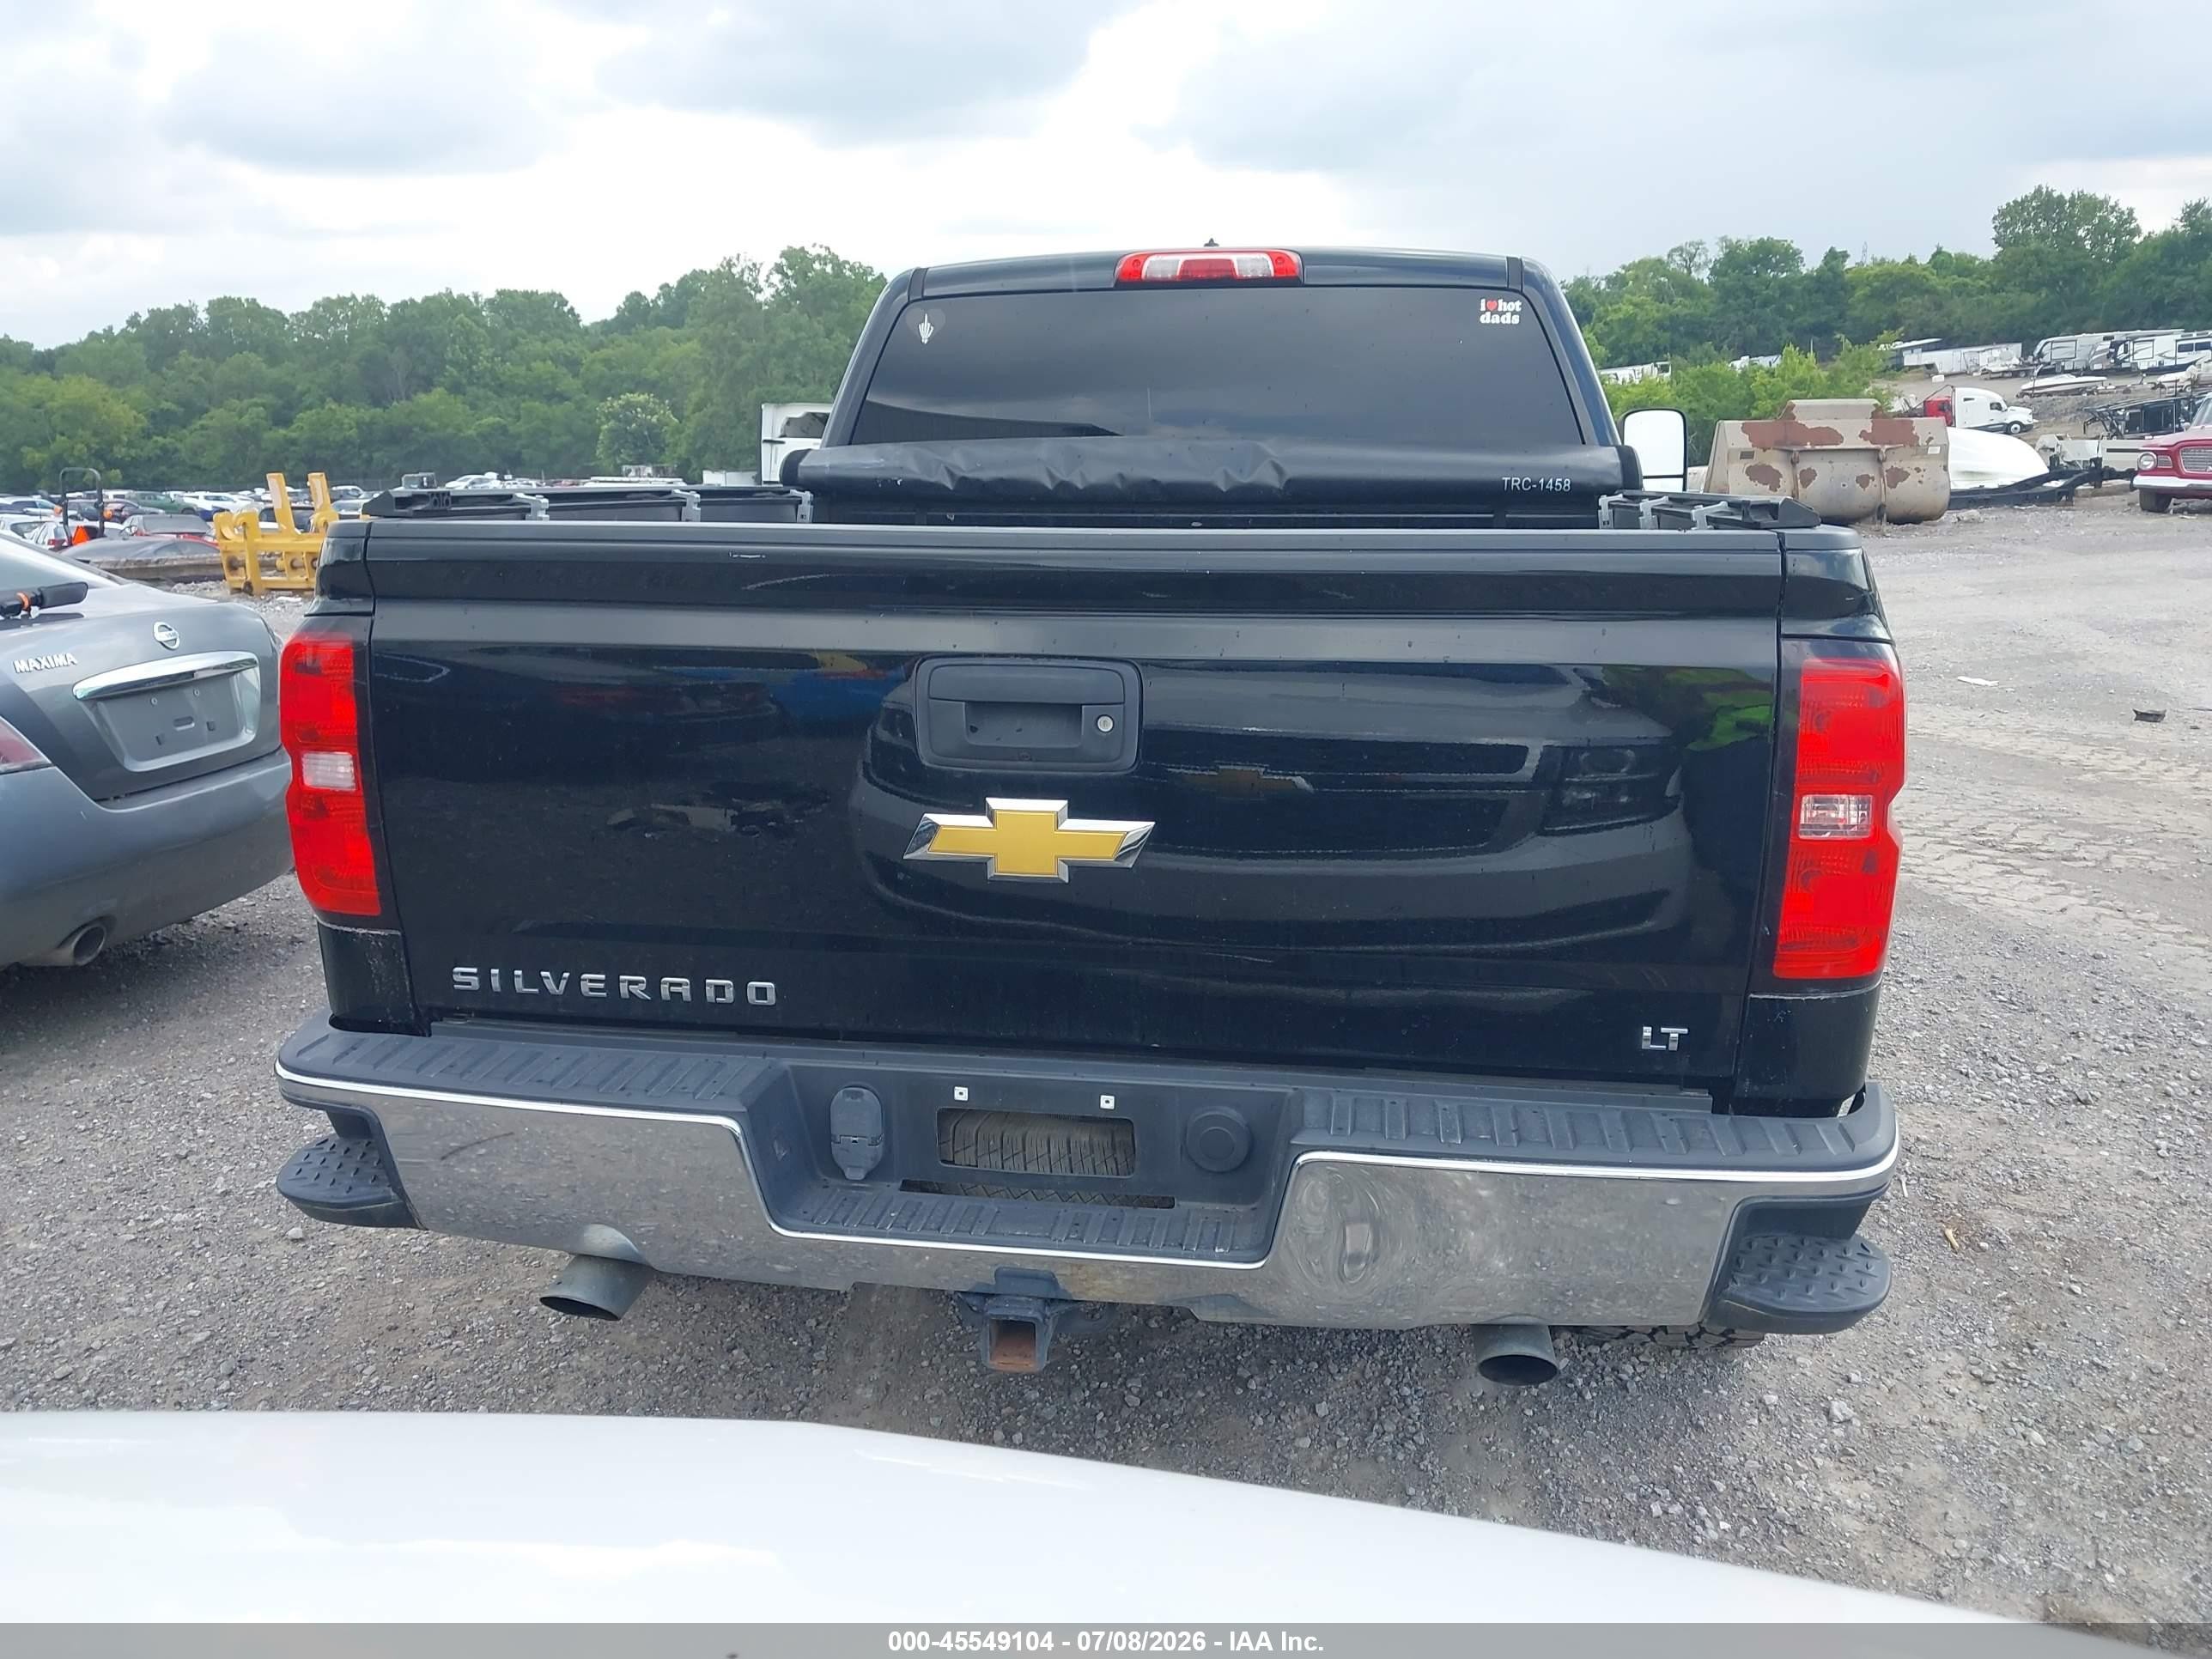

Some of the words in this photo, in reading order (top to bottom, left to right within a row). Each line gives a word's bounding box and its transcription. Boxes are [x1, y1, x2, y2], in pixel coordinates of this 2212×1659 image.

[1497, 299, 1522, 312] hot
[1480, 311, 1520, 325] dads
[1501, 477, 1571, 491] TRC-1458
[13, 653, 78, 673] MAXIMA
[452, 966, 777, 1006] SILVERADO
[1641, 1026, 1689, 1051] LT
